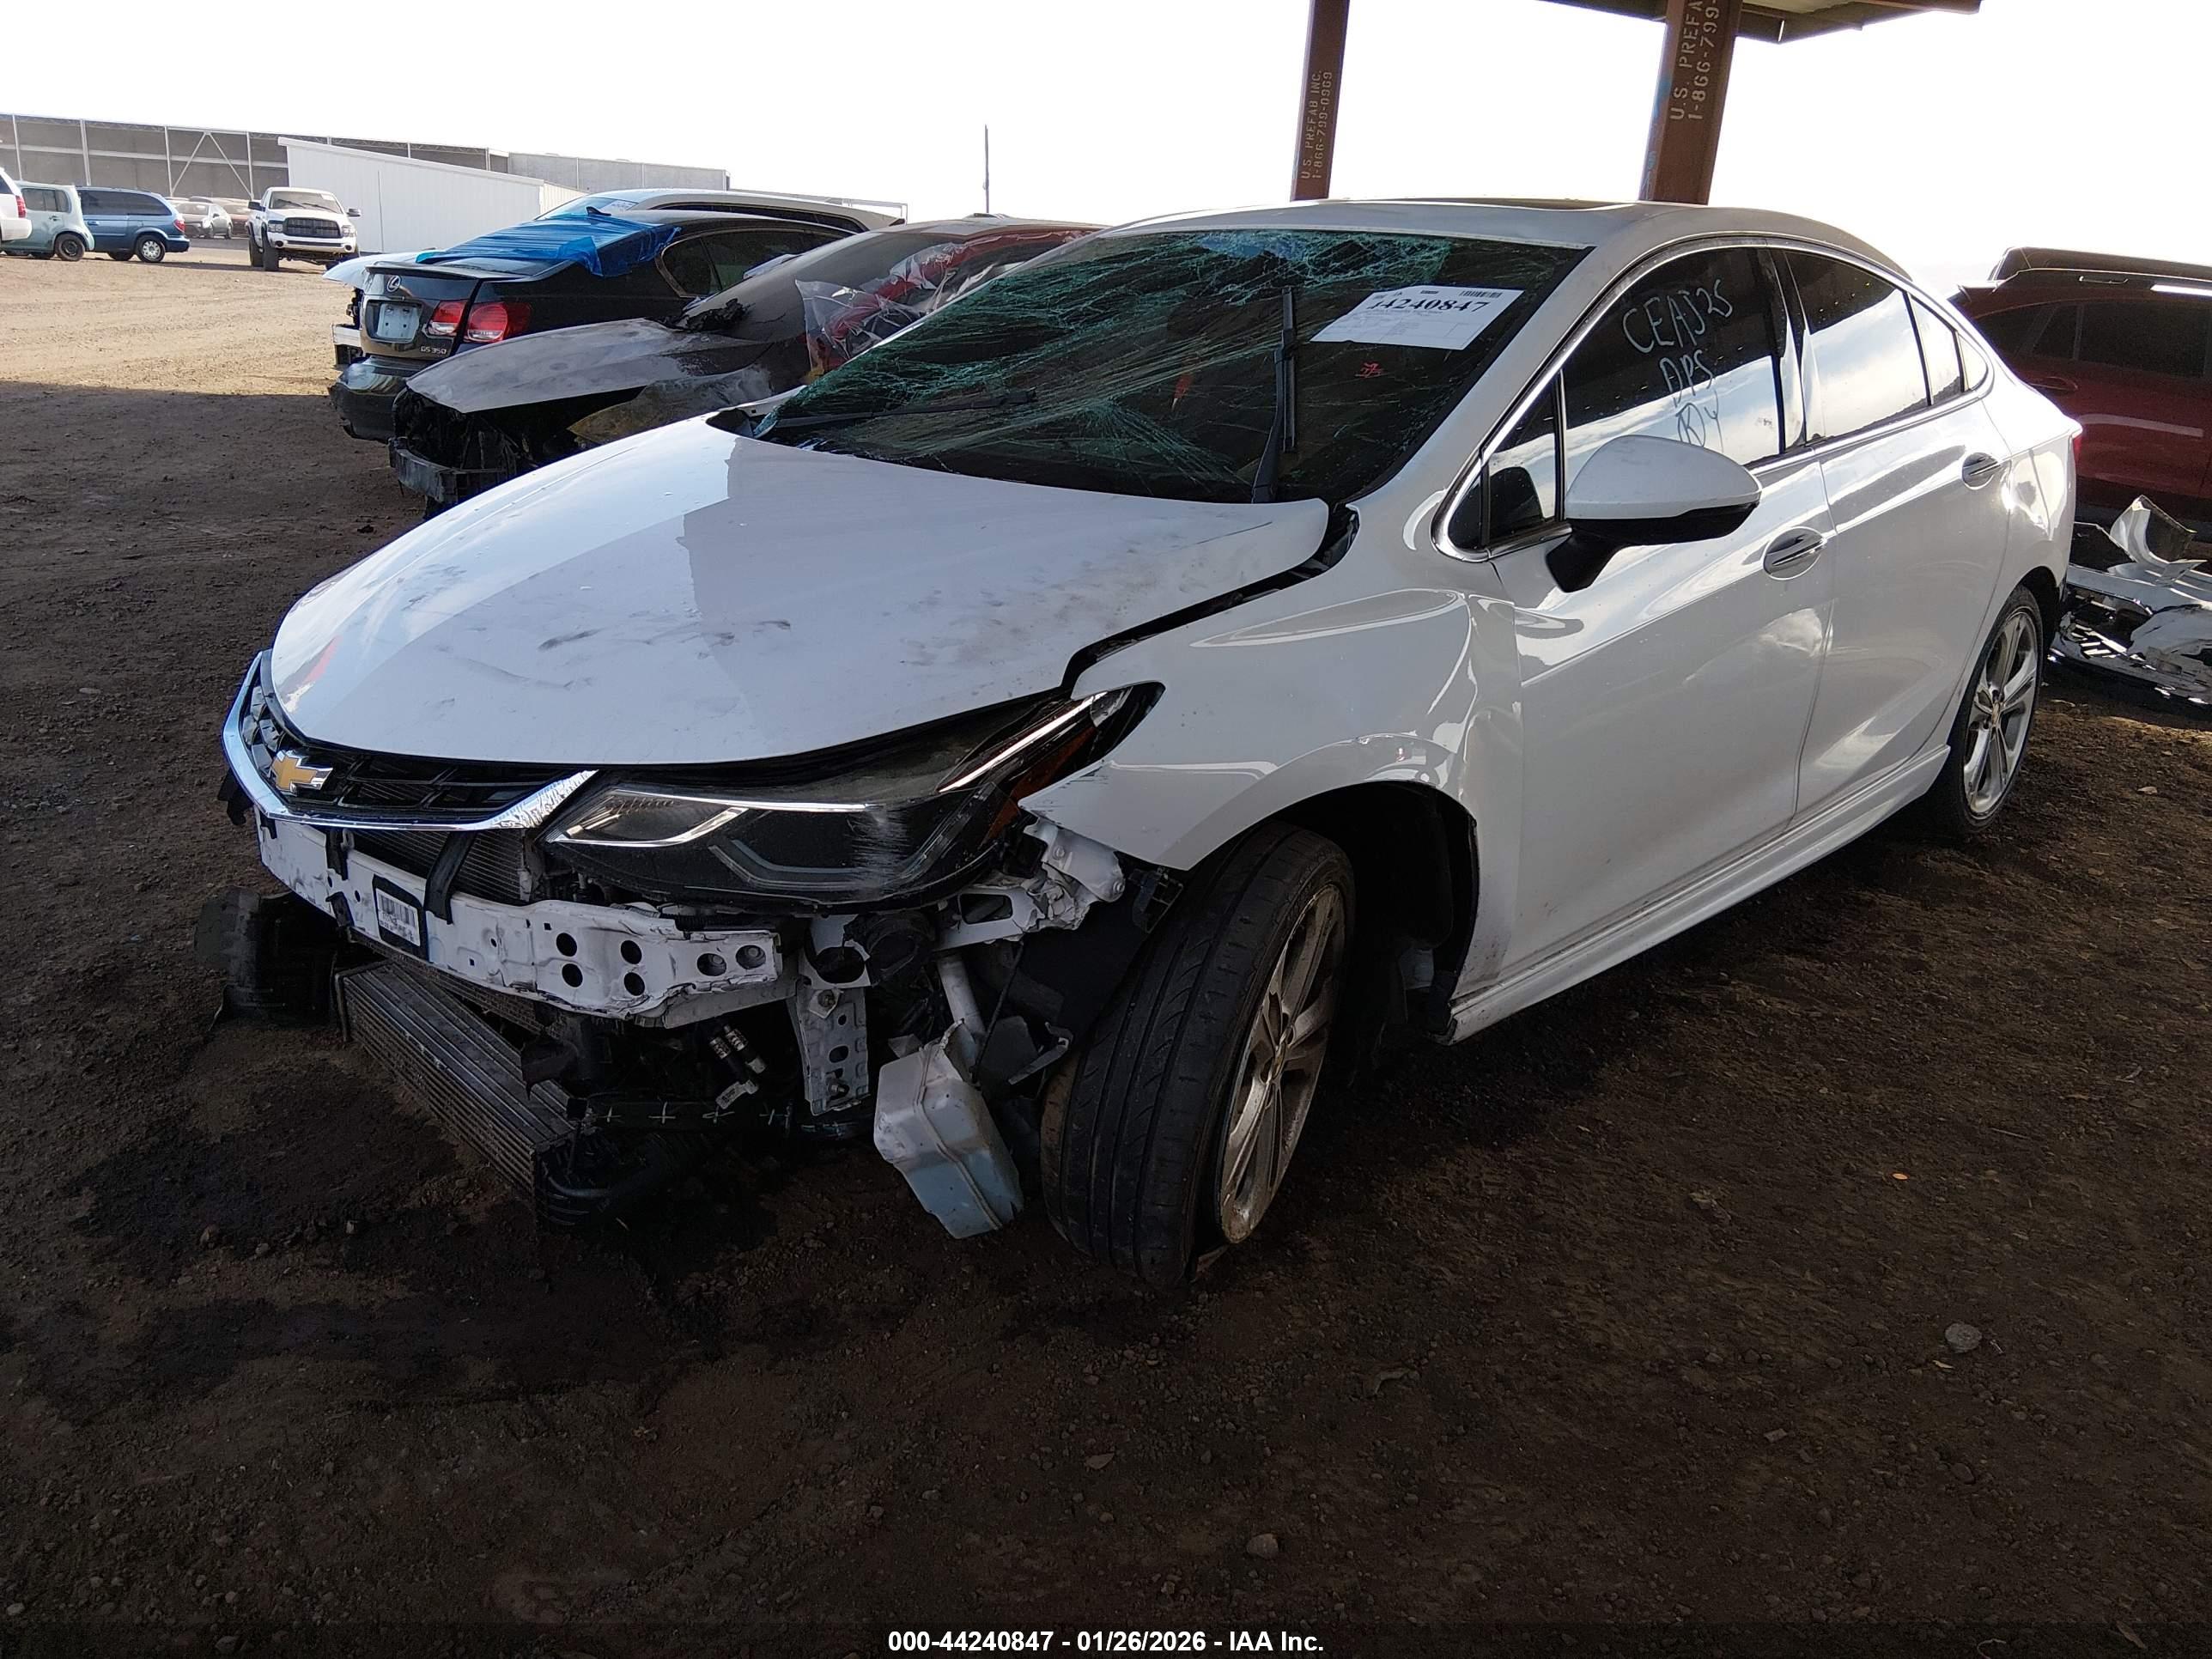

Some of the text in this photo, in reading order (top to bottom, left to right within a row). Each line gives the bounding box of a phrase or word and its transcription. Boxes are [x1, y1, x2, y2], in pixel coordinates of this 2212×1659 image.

[1310, 70, 1322, 94] INC.
[1669, 82, 1690, 120] U.S.
[1304, 100, 1319, 149] PREFAB
[1312, 71, 1333, 179] 1-866-799-0969
